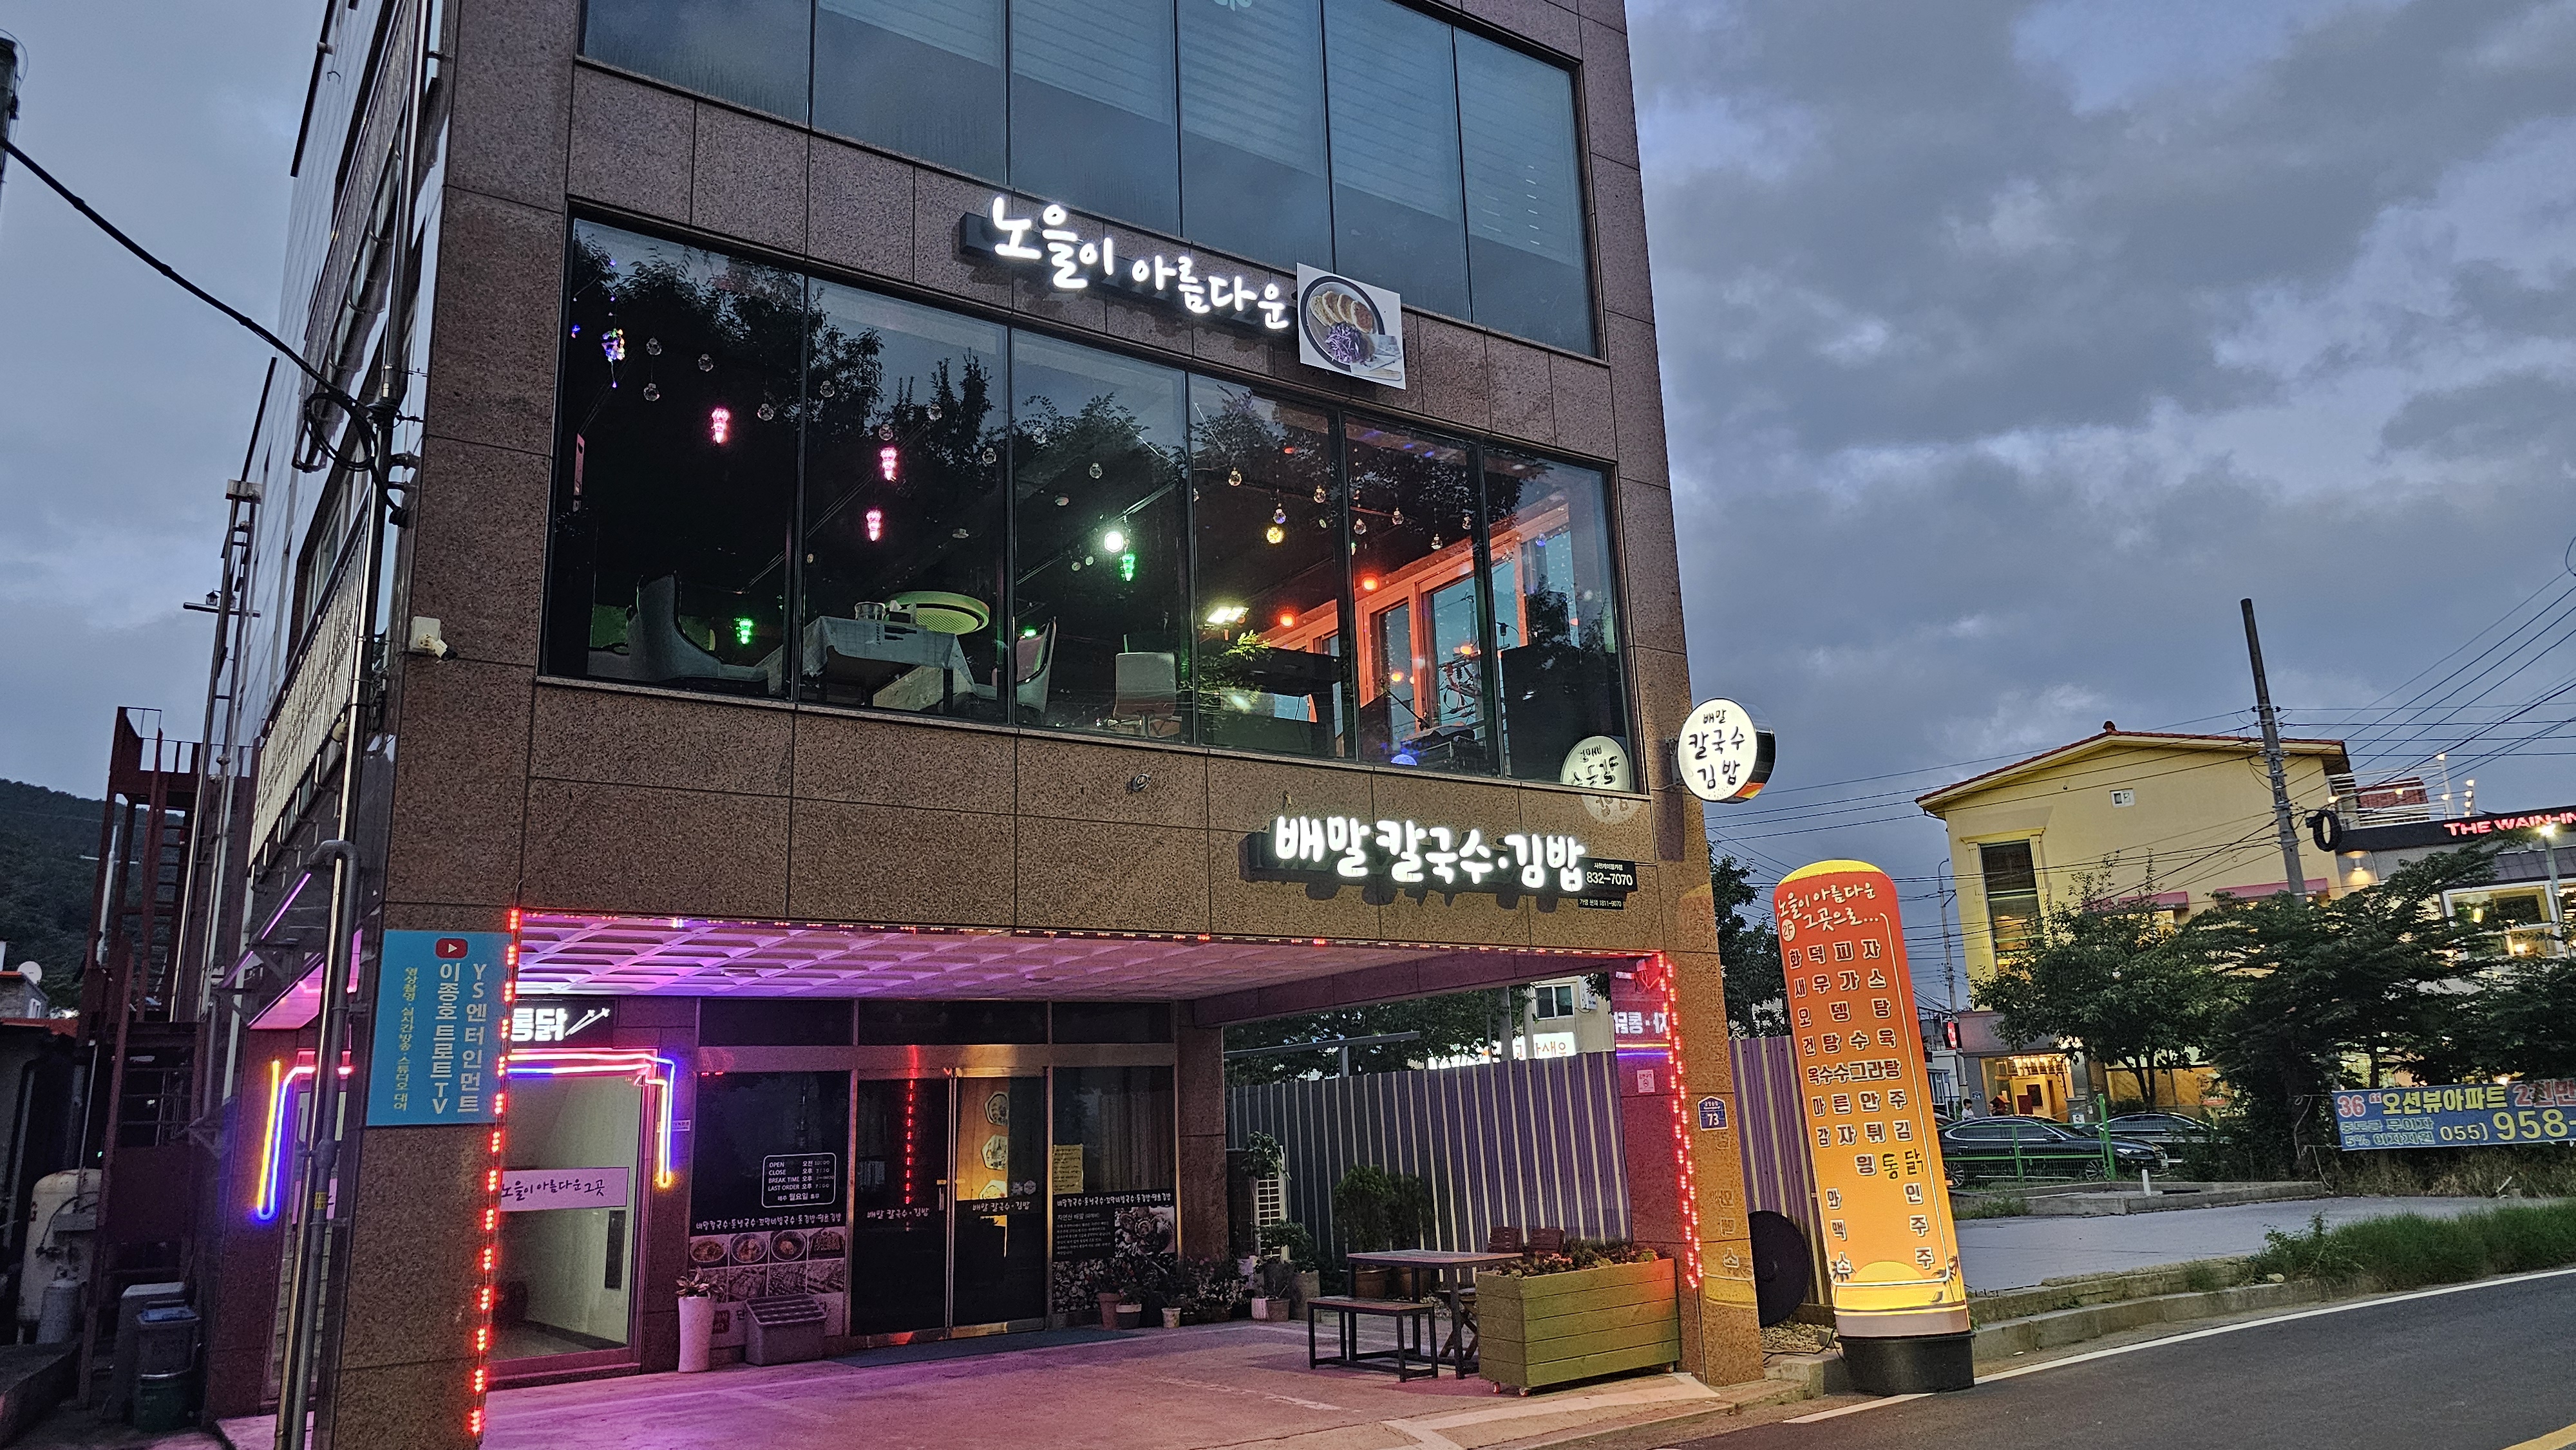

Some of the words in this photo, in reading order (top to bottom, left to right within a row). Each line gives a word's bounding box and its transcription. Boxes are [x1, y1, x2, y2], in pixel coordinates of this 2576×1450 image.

[992, 196, 1113, 289] 노을이
[1131, 256, 1289, 329] 아름다운
[1703, 709, 1727, 724] 배말
[1689, 726, 1745, 760] 칼국수
[1698, 760, 1740, 789] 김밥
[2444, 820, 2492, 836] THE
[1586, 872, 1633, 886] 832-7070
[1778, 892, 1810, 918] 노을이
[1814, 882, 1876, 903] 아름다운
[1783, 923, 1794, 937] 2F
[1788, 939, 1880, 970] 화덕피자
[1794, 969, 1887, 998] 새우가스
[511, 1008, 567, 1042] 통닭
[1799, 998, 1891, 1028] 오뎅탕
[1808, 1059, 1901, 1086] 옥수수그라탕
[1811, 1089, 1906, 1116] 마른안주
[2337, 1095, 2367, 1118] 36
[1707, 1113, 1719, 1126] 73
[2340, 1120, 2382, 1134] 중도금
[2386, 1117, 2434, 1131] 무이자
[2439, 1122, 2489, 1142] 055)
[1816, 1119, 1912, 1148] 감자튀김
[2345, 1134, 2371, 1146] 5%
[2373, 1131, 2435, 1145] 이자지원
[502, 1180, 533, 1201] 노을이
[537, 1179, 581, 1193] 아름다운
[584, 1179, 605, 1196] 그곳
